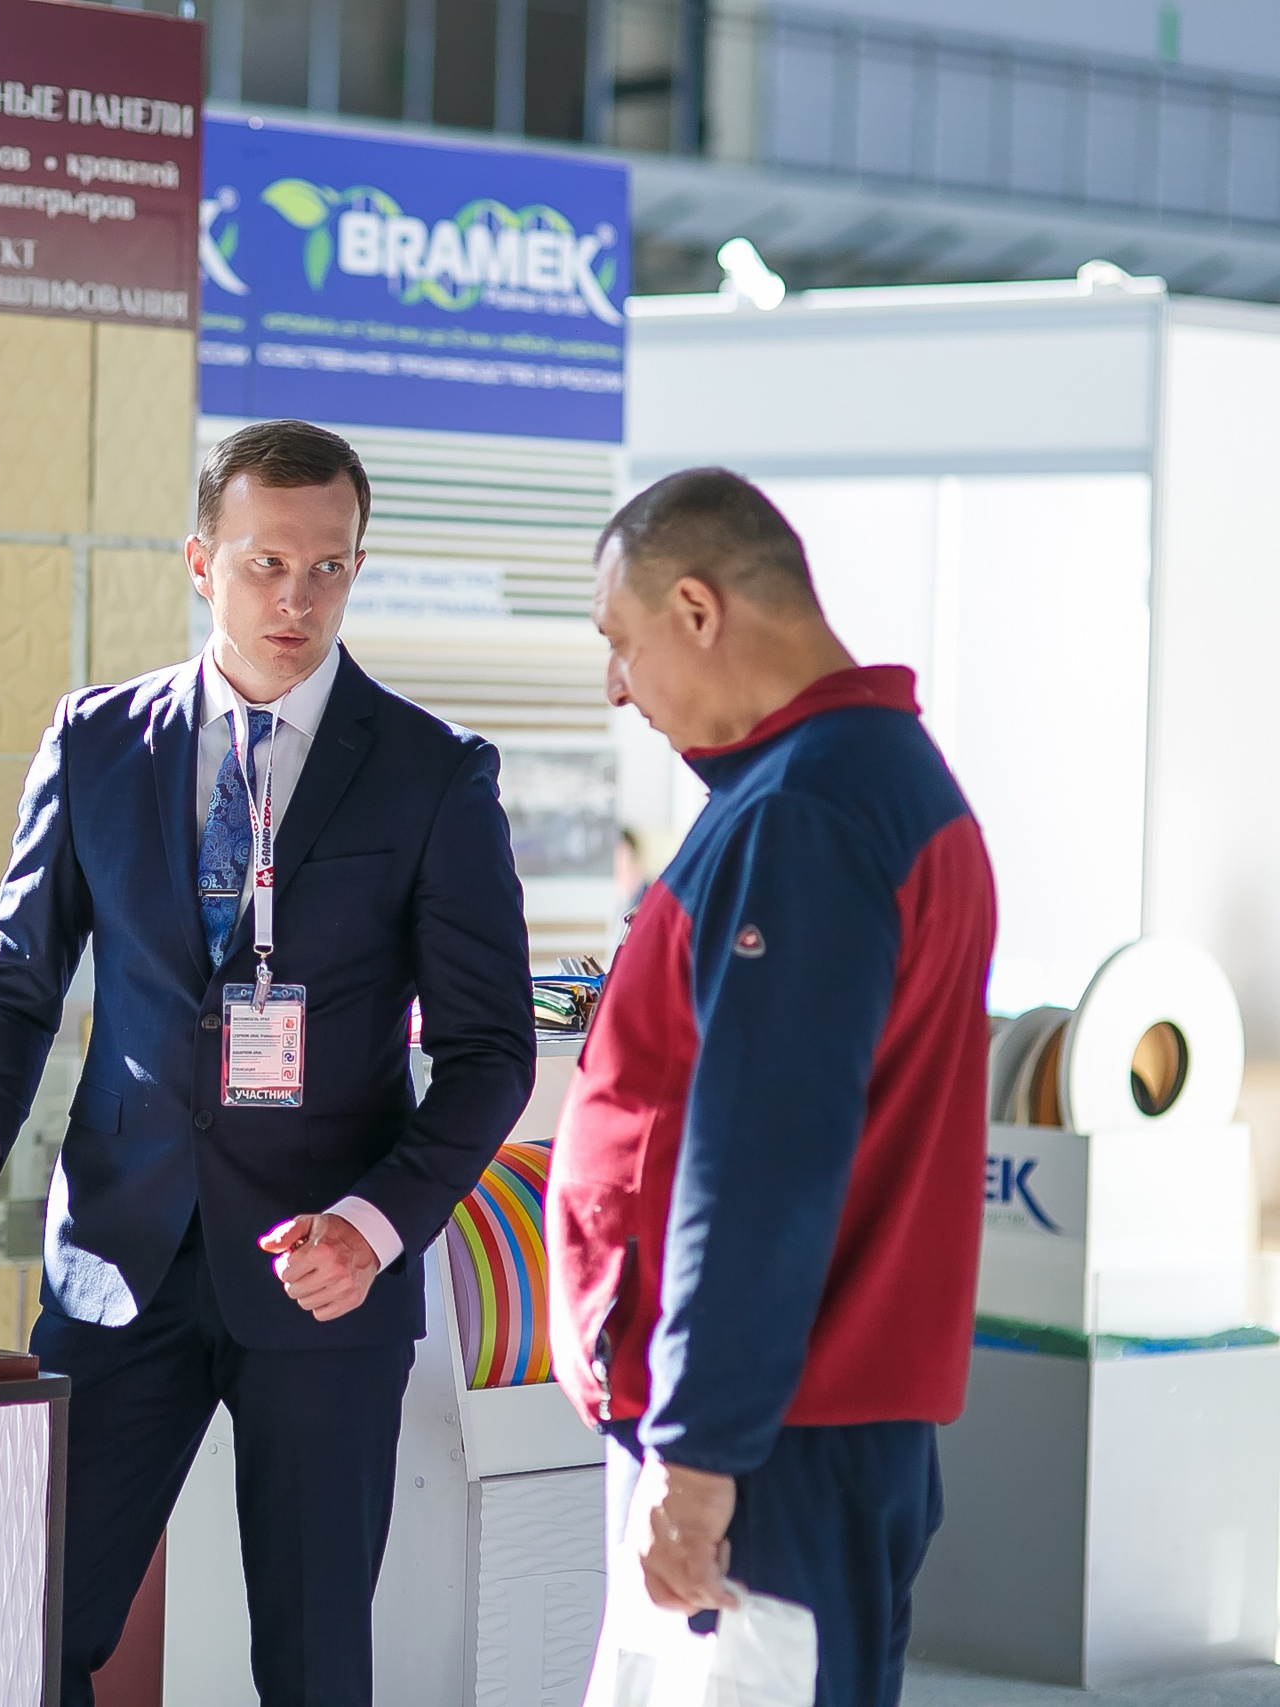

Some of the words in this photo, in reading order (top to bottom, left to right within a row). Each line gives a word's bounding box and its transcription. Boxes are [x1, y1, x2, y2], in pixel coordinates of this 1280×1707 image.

[68, 88, 195, 139] ПАНЕЛИ
[337, 211, 623, 328] BRAMEK
[235, 1089, 292, 1100] УЧАСТНИК
